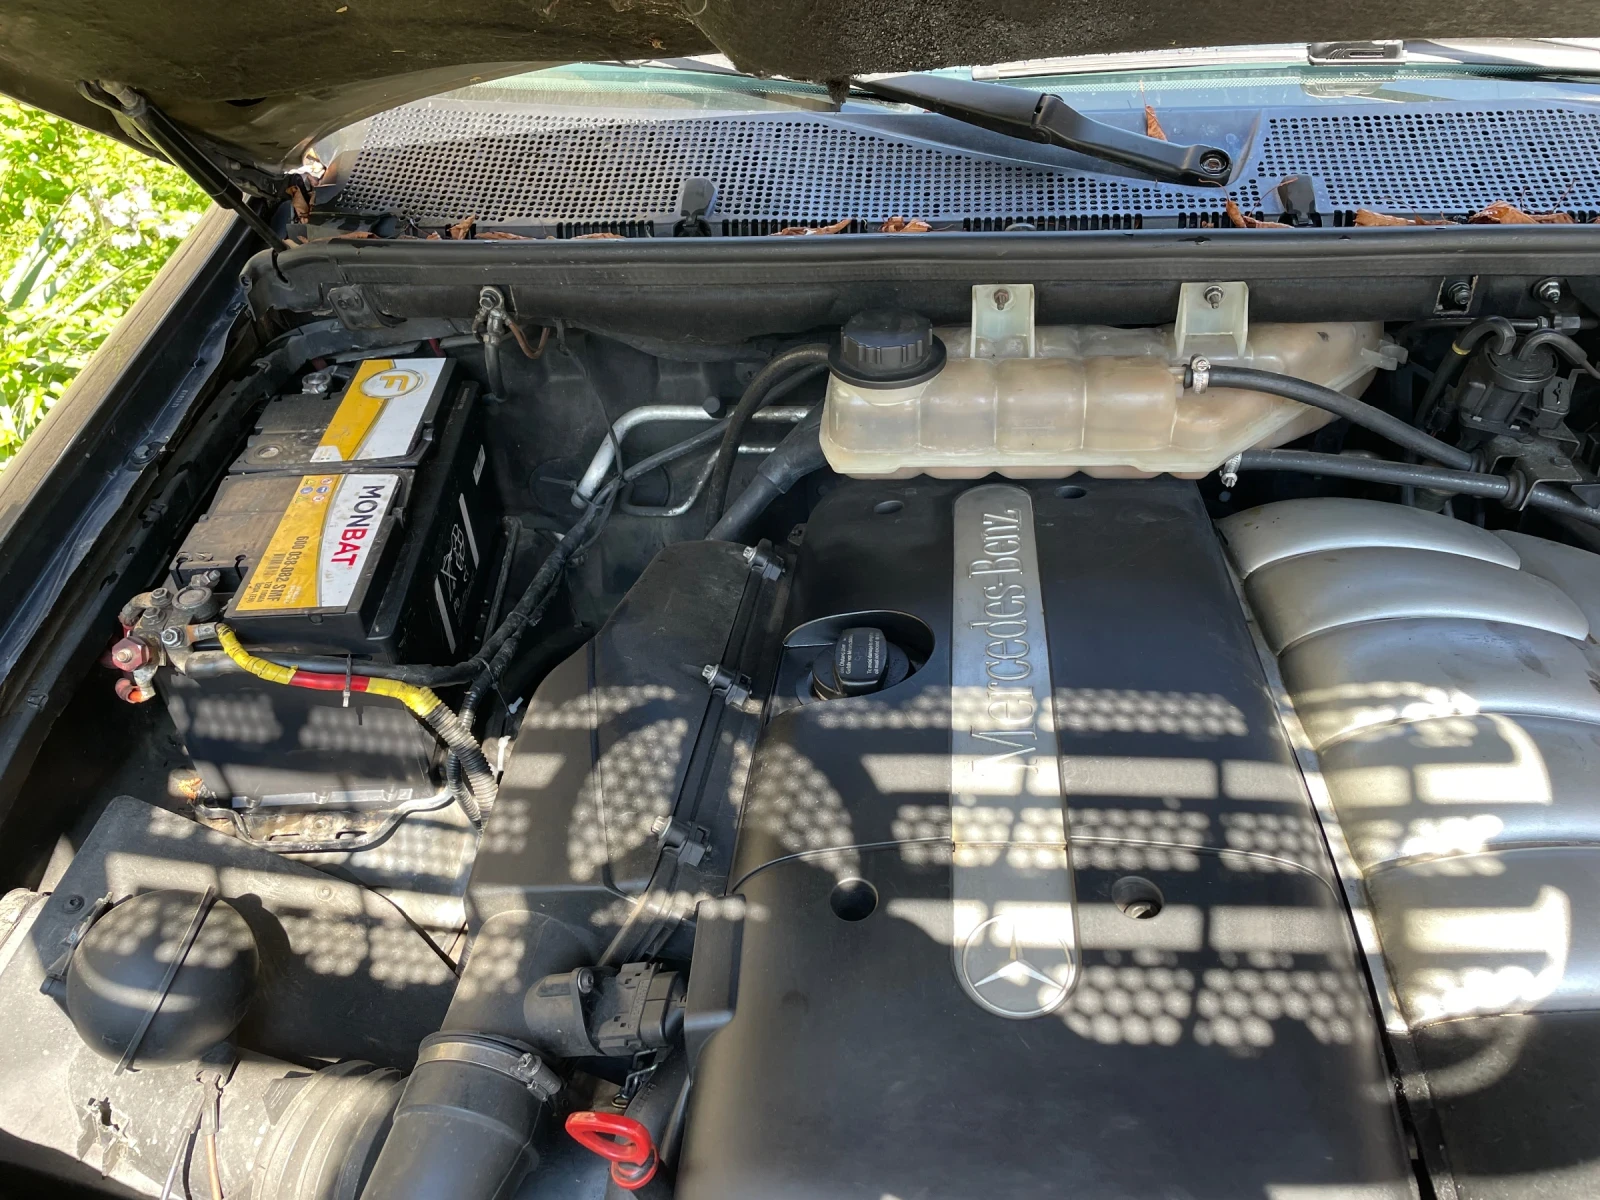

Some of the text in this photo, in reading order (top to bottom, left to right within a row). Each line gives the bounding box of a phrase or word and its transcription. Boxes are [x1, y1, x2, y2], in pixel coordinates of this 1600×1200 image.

[292, 536, 309, 549] 600
[331, 485, 385, 566] MONBAT
[267, 584, 287, 602] SMF
[969, 508, 1037, 773] Mercedes-Benz
